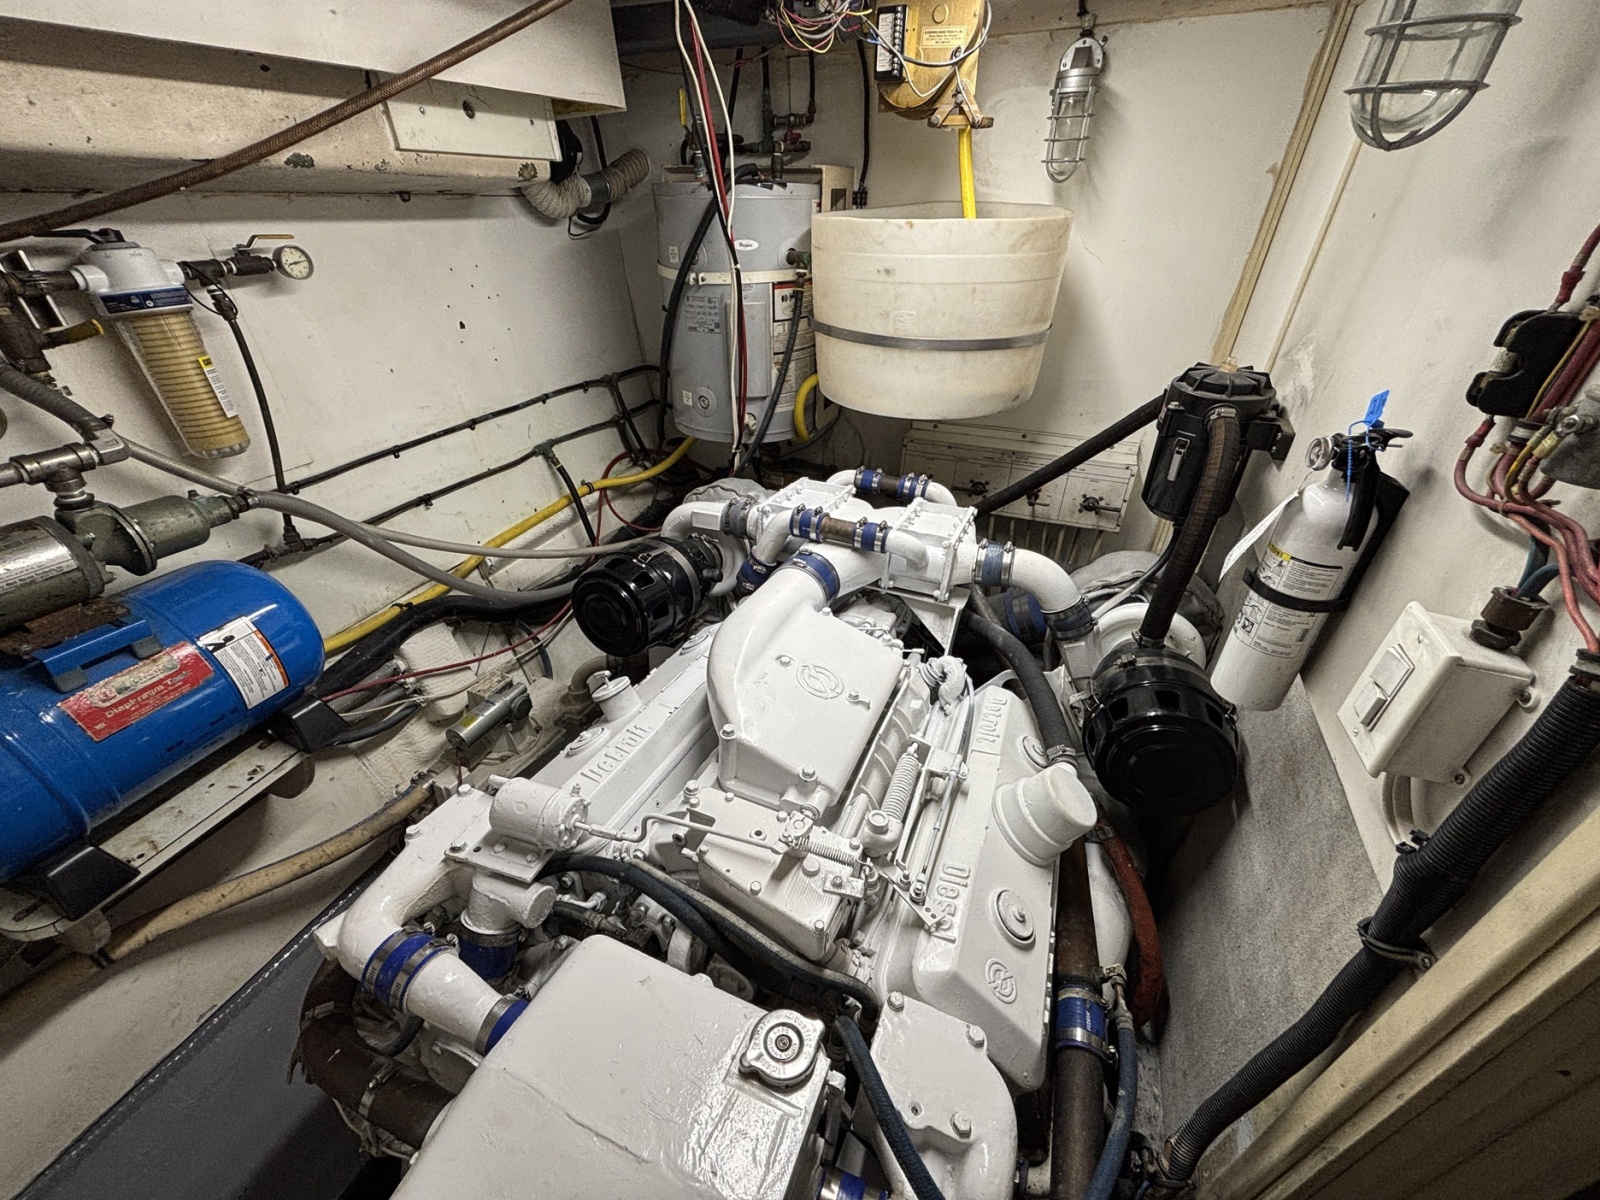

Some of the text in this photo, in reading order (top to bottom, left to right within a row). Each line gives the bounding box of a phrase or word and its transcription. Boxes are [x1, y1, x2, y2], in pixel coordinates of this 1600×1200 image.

[105, 684, 165, 718] Diaphragm
[976, 698, 1008, 748] Detroit
[580, 724, 652, 784] Detroit
[931, 863, 972, 944] Diesel
